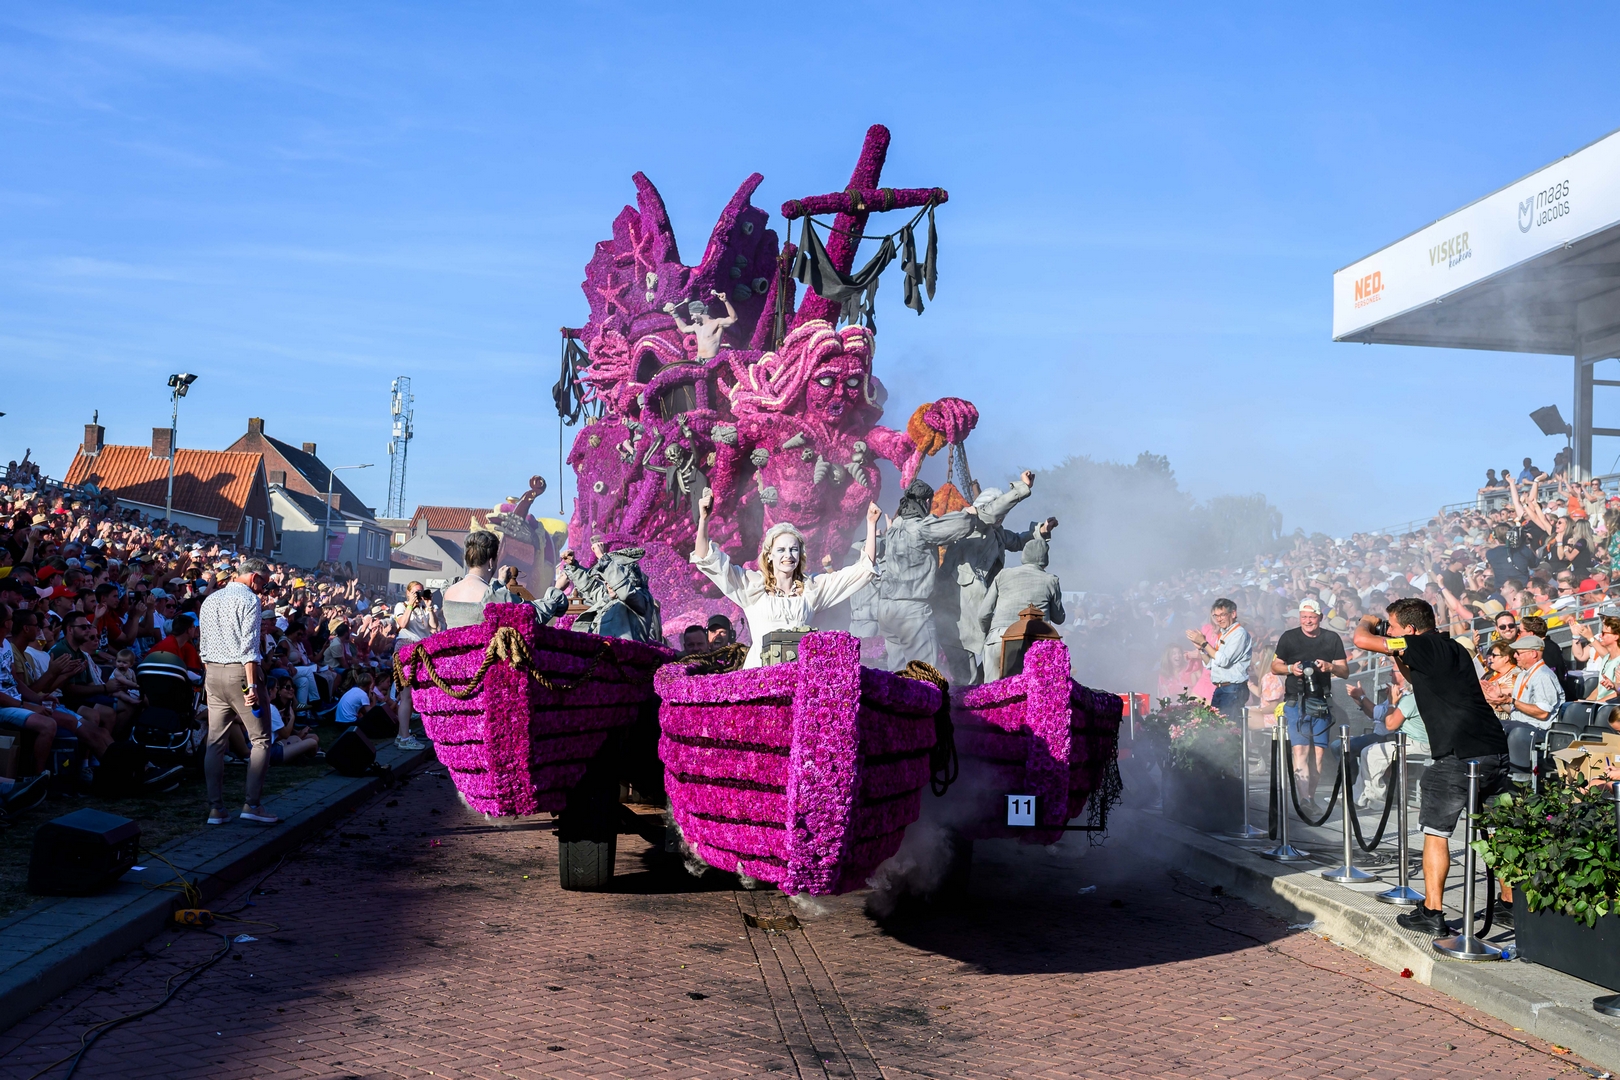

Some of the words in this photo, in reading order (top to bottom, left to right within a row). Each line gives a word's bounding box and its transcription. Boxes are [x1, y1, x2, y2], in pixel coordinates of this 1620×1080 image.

[1536, 179, 1569, 210] maas
[1429, 231, 1469, 266] VISKER
[1355, 270, 1385, 302] NED.
[1011, 798, 1031, 815] 11
